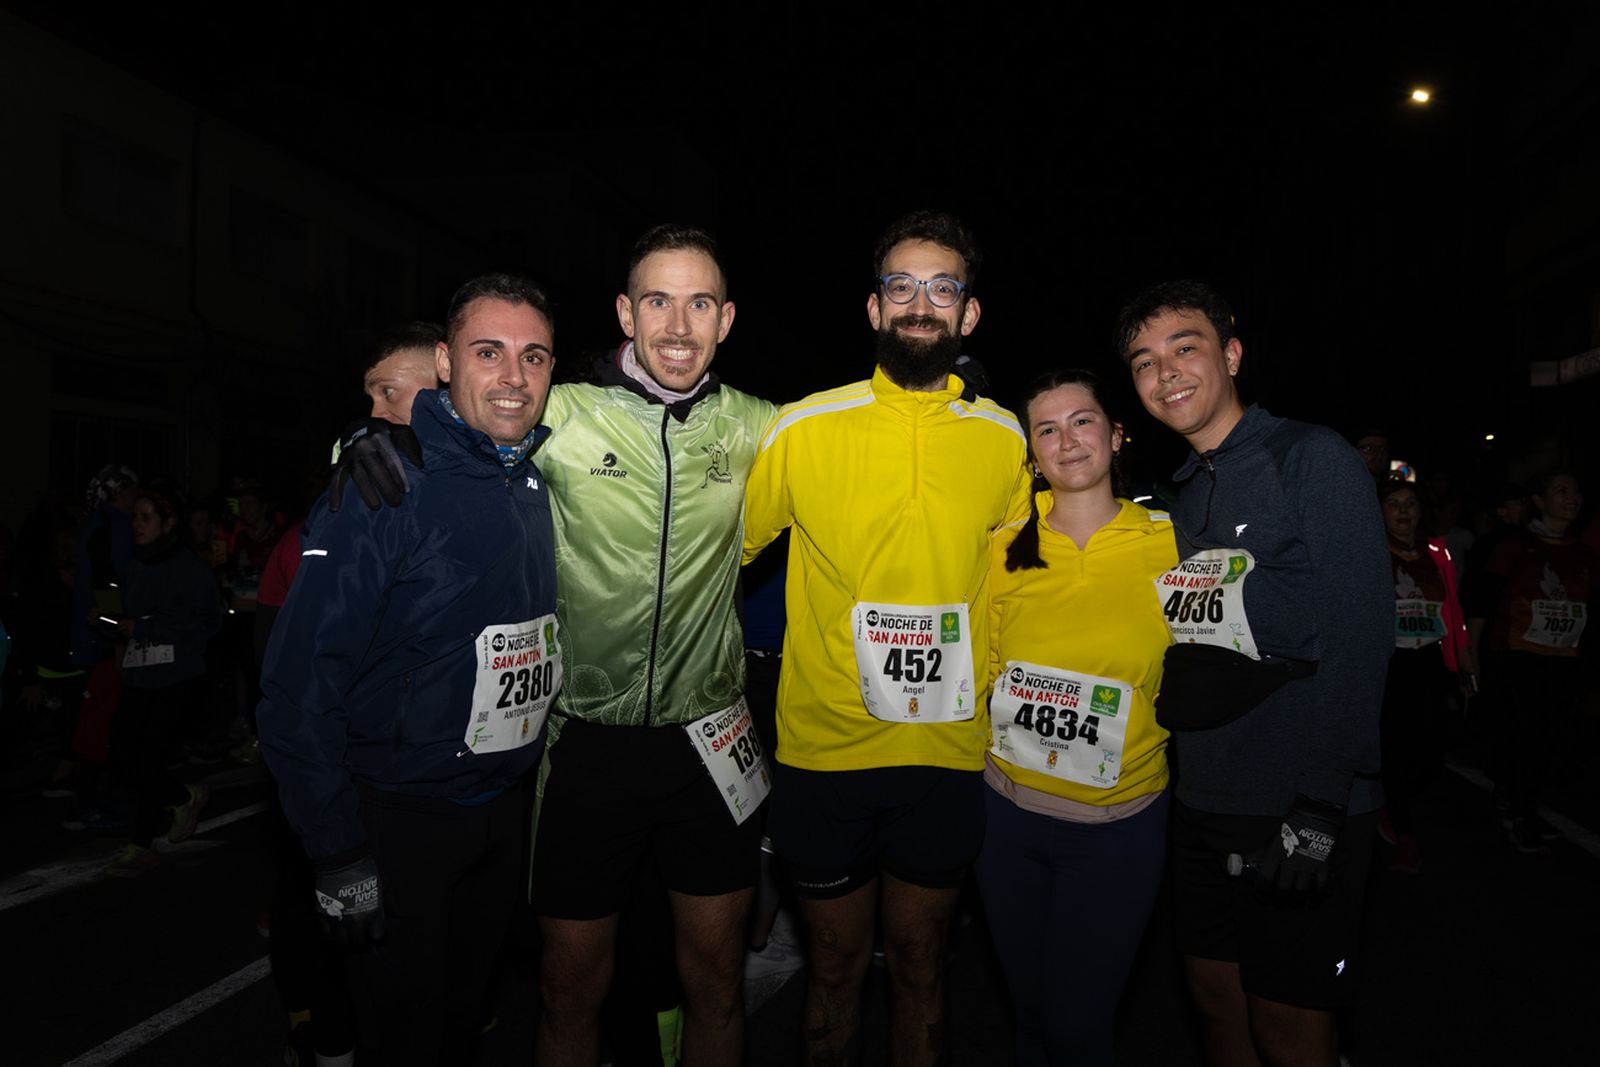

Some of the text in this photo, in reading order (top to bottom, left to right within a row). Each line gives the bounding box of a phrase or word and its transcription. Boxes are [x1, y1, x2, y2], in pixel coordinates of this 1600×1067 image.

[589, 467, 628, 479] VIATOR
[1180, 563, 1223, 575] NOCHE DE
[1163, 574, 1187, 588] SAN
[1164, 588, 1225, 624] 4836
[880, 617, 933, 631] NOCHE DE
[1398, 616, 1436, 633] 4062
[1544, 617, 1576, 633] 7037
[507, 635, 534, 652] NOCHE
[866, 630, 890, 645] SAN
[890, 631, 932, 646] ANTÓN
[492, 653, 516, 670] SAN
[884, 648, 942, 683] 452
[496, 660, 553, 709] 2380
[1009, 684, 1033, 701] SAN
[1024, 676, 1064, 693] NOCHE
[1066, 684, 1082, 696] DE
[716, 706, 742, 733] NOCHE
[1014, 702, 1100, 746] 4834
[712, 731, 735, 753] SAN
[1039, 738, 1070, 752] Cristina
[354, 887, 378, 904] SAN
